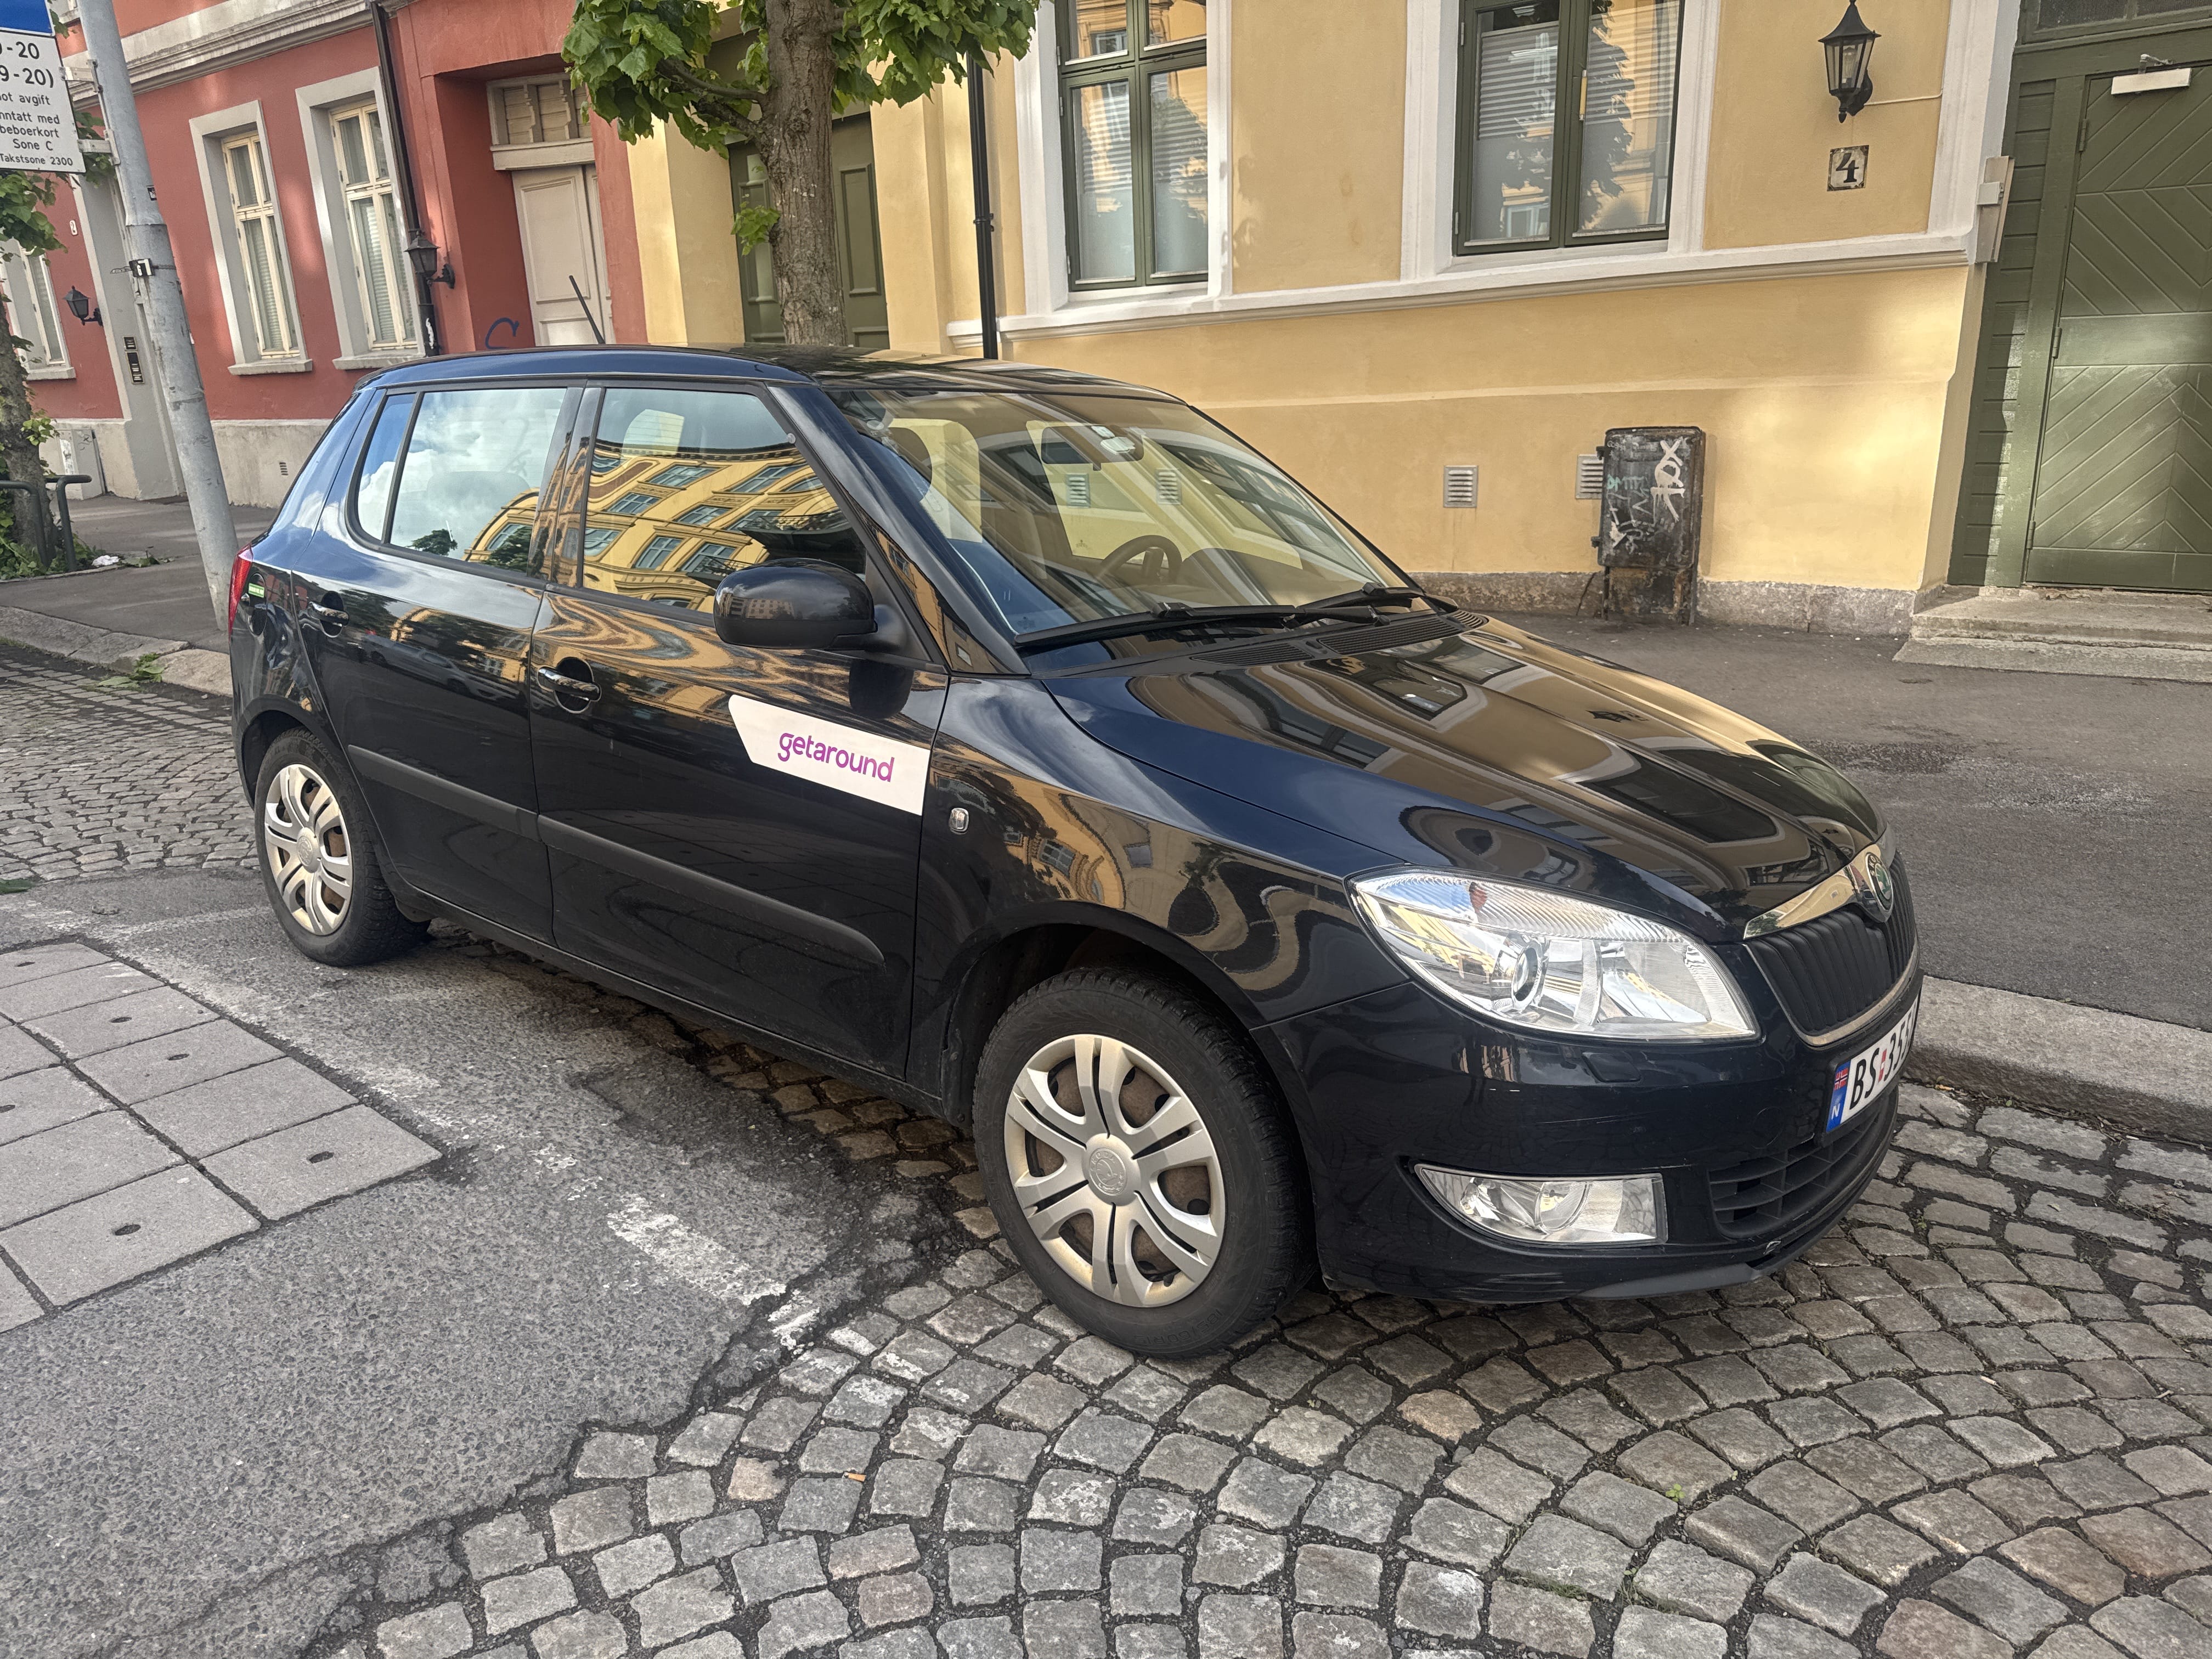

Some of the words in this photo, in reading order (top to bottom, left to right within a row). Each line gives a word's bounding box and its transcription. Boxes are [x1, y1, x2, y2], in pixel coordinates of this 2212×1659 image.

[0, 41, 40, 59] -20
[0, 92, 13, 102] ot
[19, 94, 50, 106] avgift
[37, 115, 60, 124] med
[0, 125, 59, 138] beboerkort
[13, 138, 40, 150] Sone
[46, 141, 53, 151] C
[0, 153, 46, 165] Takstsone
[50, 156, 73, 166] 2300
[1836, 153, 1859, 183] 4
[777, 732, 895, 782] getaround
[1849, 1047, 1880, 1110] BS
[1831, 1103, 1841, 1120] N
